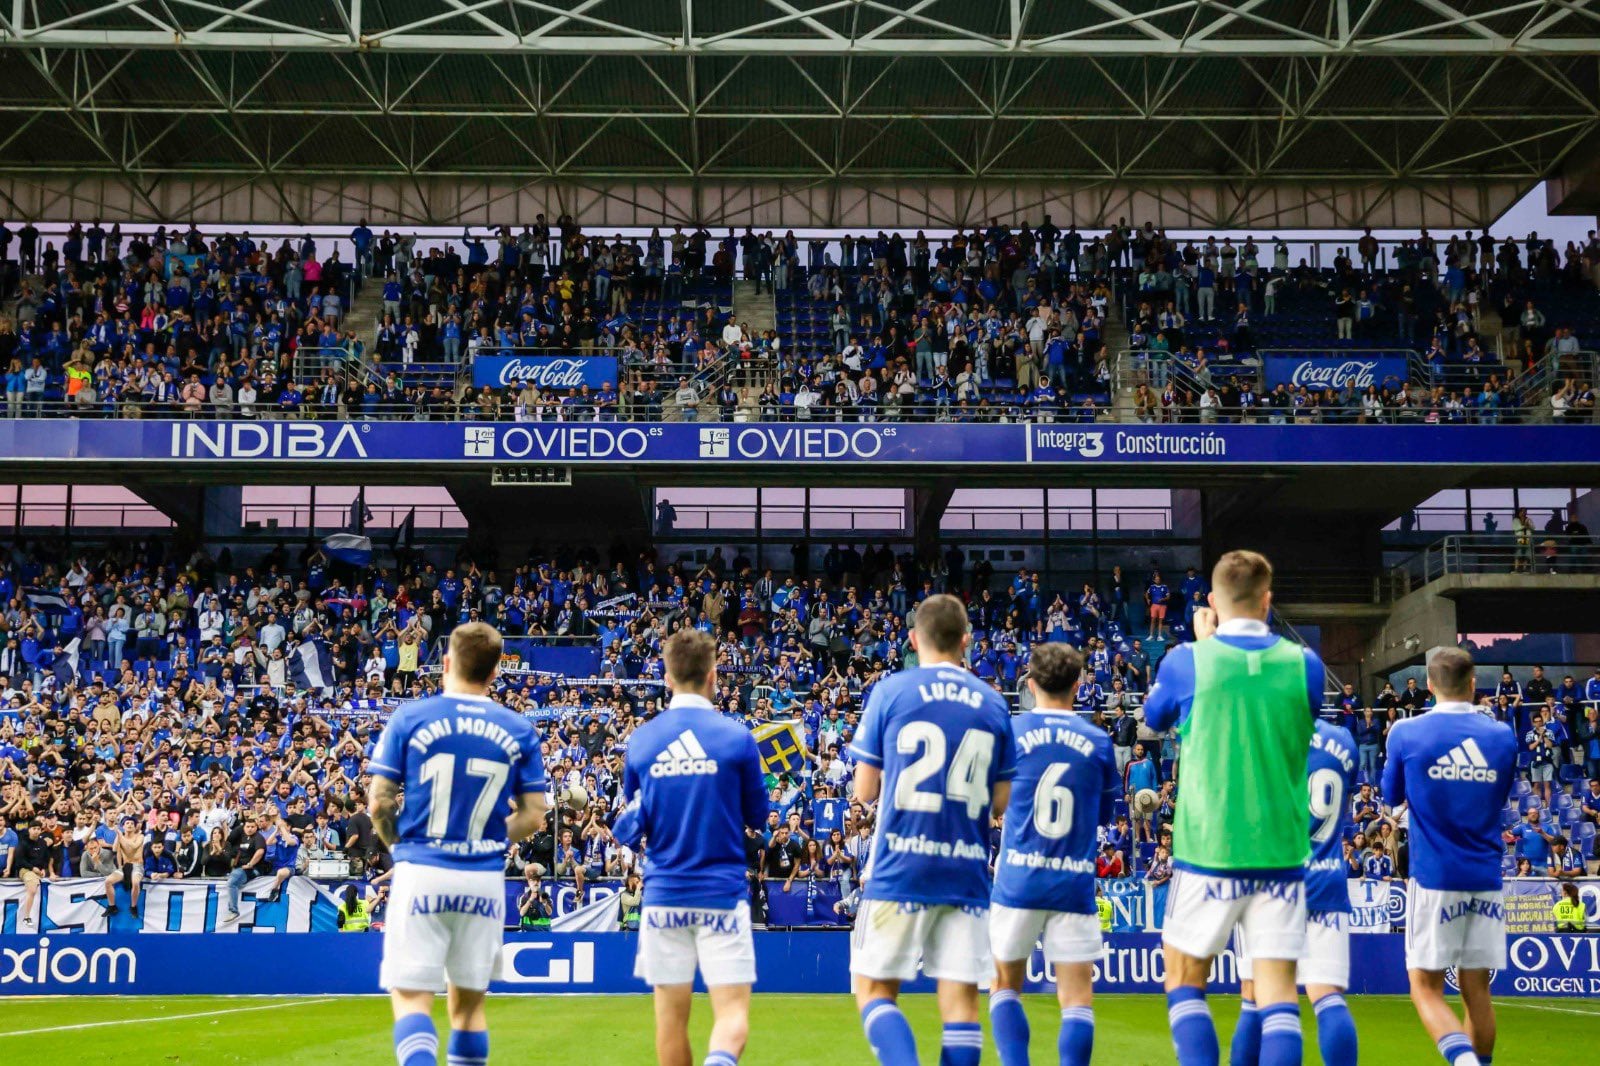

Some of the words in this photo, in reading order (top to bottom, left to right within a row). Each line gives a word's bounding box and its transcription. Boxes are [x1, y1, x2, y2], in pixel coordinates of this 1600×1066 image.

[1116, 431, 1226, 455] Construcción
[918, 681, 984, 709] LUCAS
[525, 709, 550, 718] PROUD
[408, 717, 452, 754] JONI
[1017, 727, 1052, 754] JAVI
[1055, 727, 1095, 758] MIER
[650, 757, 718, 778] adidas
[894, 720, 996, 821] 24
[1427, 763, 1497, 783] adidas
[419, 752, 511, 842] 17
[1033, 762, 1075, 840] 6
[823, 802, 834, 821] 4
[885, 831, 952, 857] Tartiere
[1006, 847, 1060, 869] Tartiere
[411, 893, 500, 920] ALIMERK
[646, 911, 740, 933] ALIMERKA
[1514, 976, 1585, 993] ORIGEN
